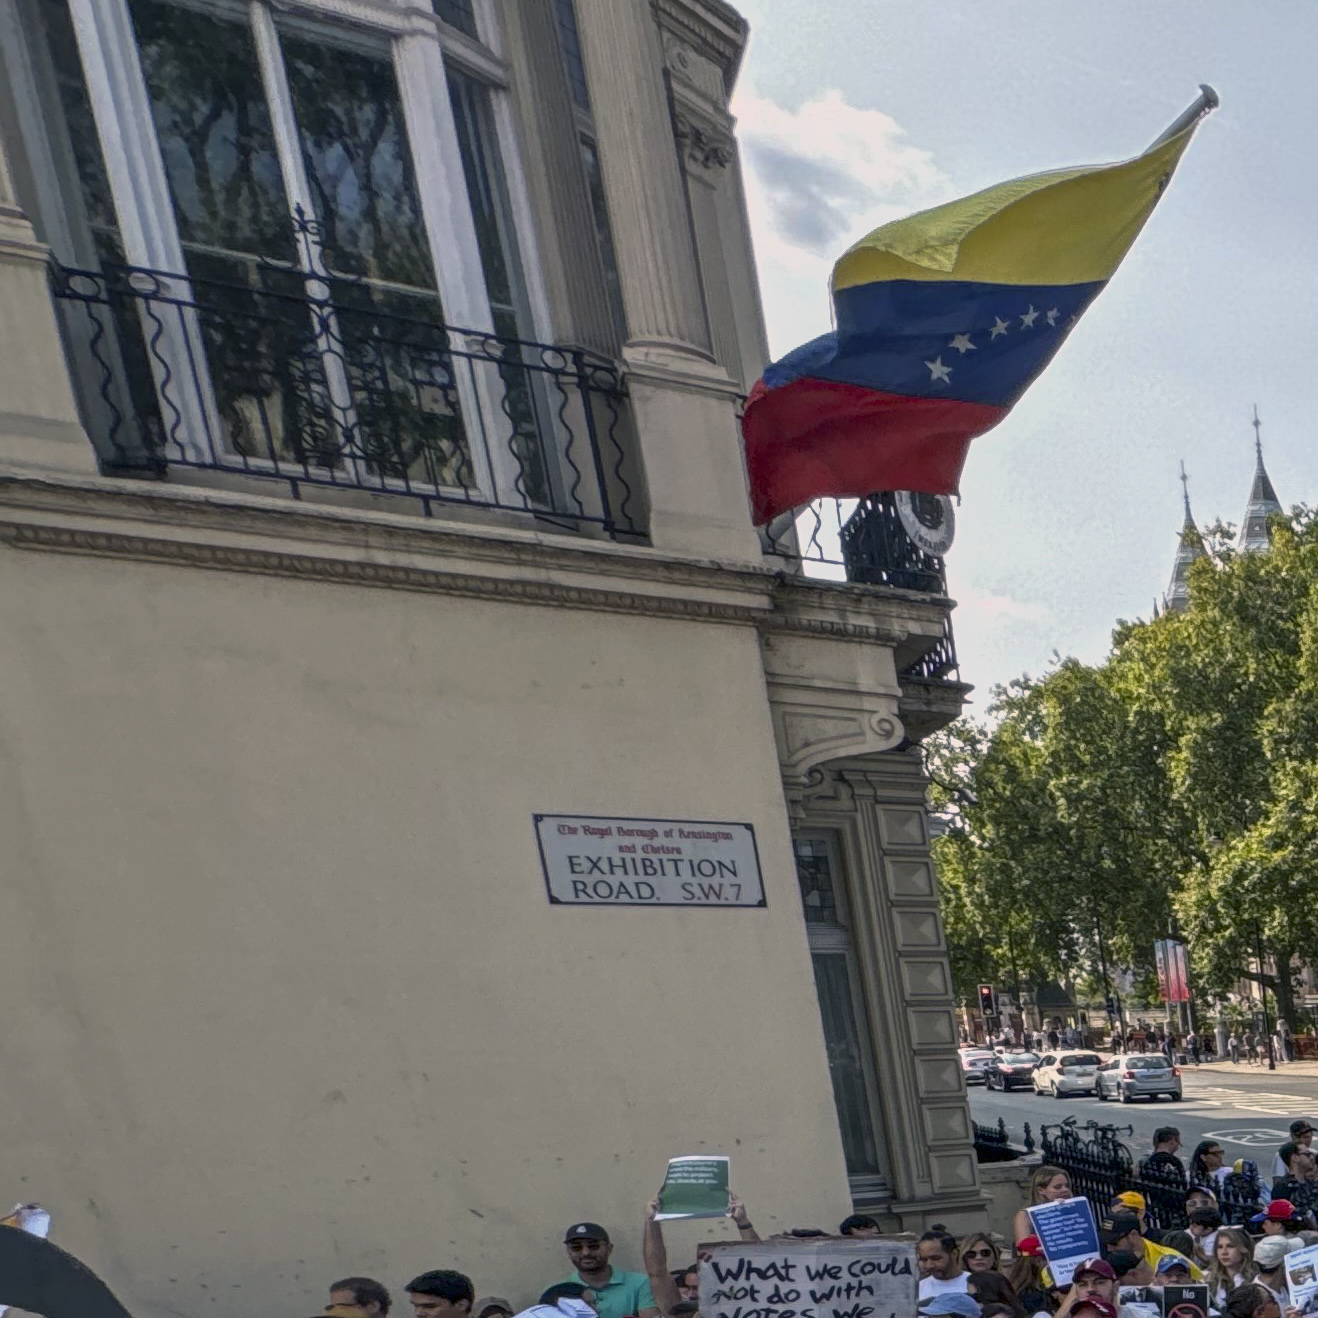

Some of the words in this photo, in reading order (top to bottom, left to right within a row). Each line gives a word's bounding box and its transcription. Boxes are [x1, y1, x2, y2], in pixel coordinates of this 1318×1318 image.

[557, 824, 578, 836] The
[581, 825, 612, 839] Royal
[617, 826, 659, 840] Borough
[663, 828, 673, 839] of
[678, 828, 733, 842] Kensington
[618, 843, 636, 854] and
[641, 844, 682, 855] Chelsea
[567, 855, 738, 879] EXHIBITION
[805, 1263, 842, 1281] we
[766, 1284, 801, 1309] do
[809, 1280, 874, 1305] with
